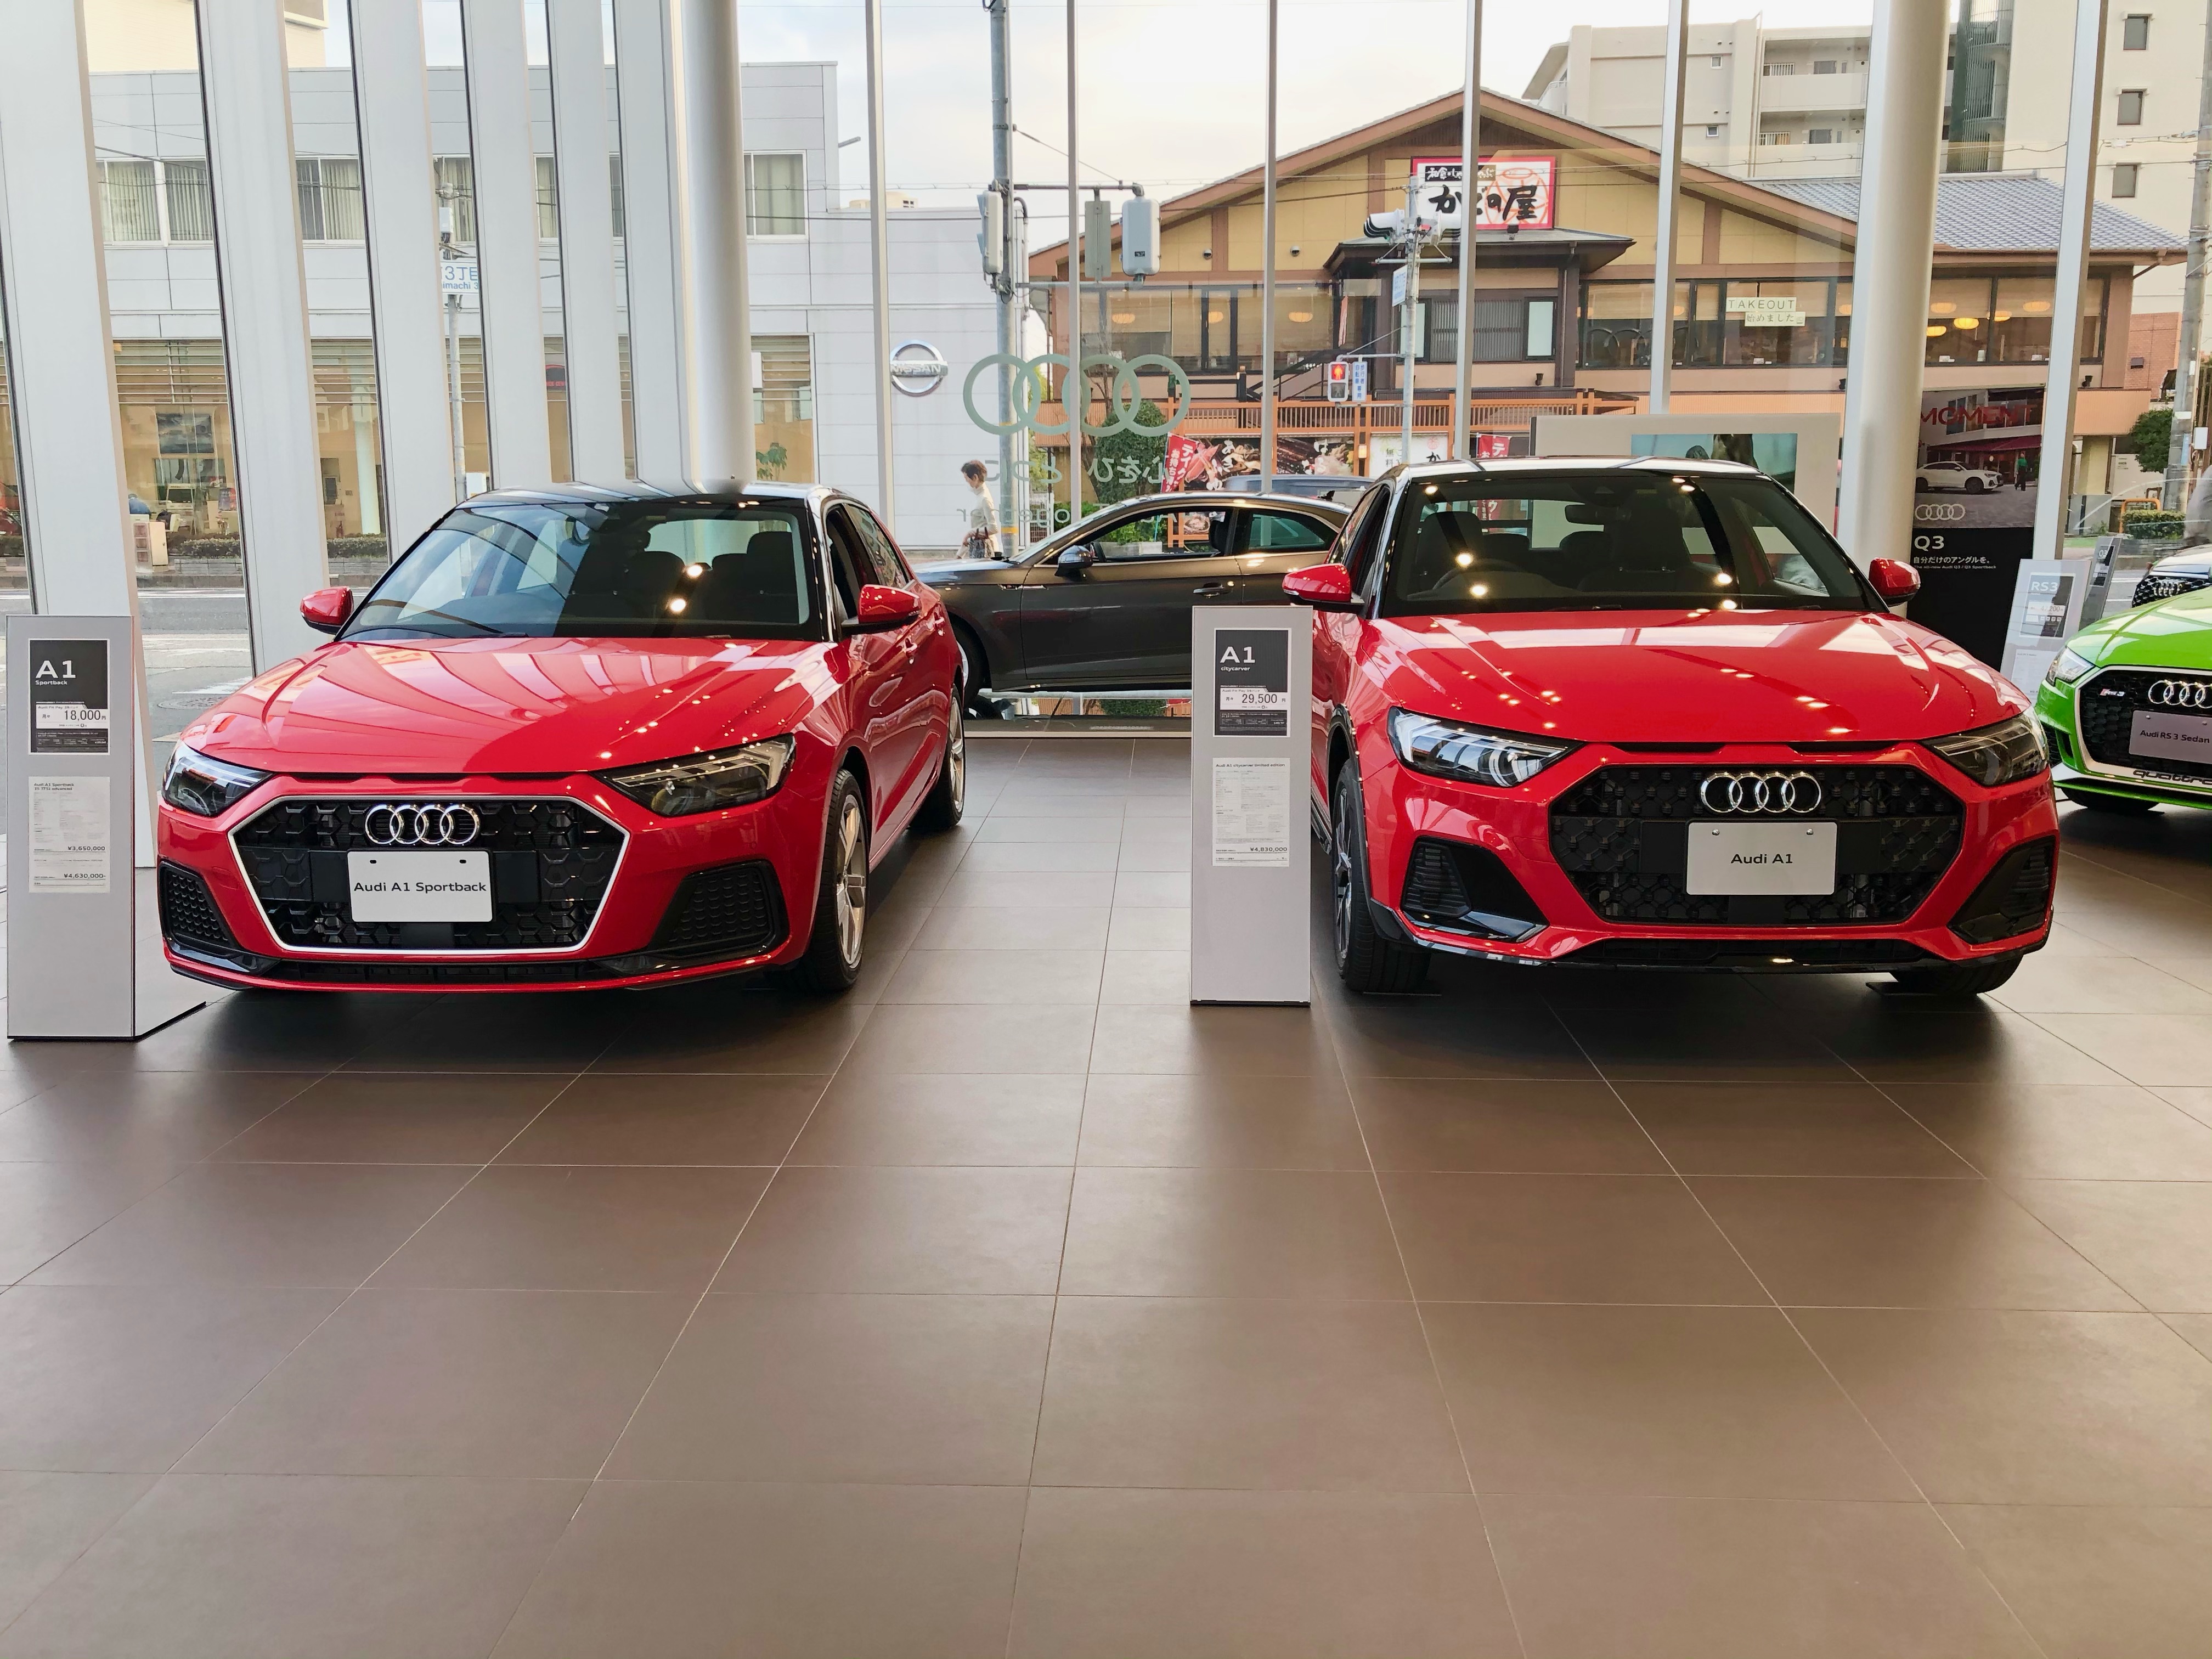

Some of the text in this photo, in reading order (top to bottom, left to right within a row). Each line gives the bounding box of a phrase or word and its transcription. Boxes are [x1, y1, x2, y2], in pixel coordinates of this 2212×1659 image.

[1729, 300, 1795, 309] TAKEOUT
[1747, 314, 1794, 323] 始めました
[890, 364, 941, 373] NISSAN
[1914, 535, 1945, 551] Q3
[1220, 646, 1255, 663] A1
[35, 660, 76, 678] A1
[1242, 693, 1278, 704] 29,500
[64, 710, 101, 721] 18,000
[2140, 730, 2159, 738] Audi
[2181, 734, 2210, 743] Sedan
[1730, 854, 1793, 864] Audi A1
[354, 882, 487, 894] Audi A1 Sportback
